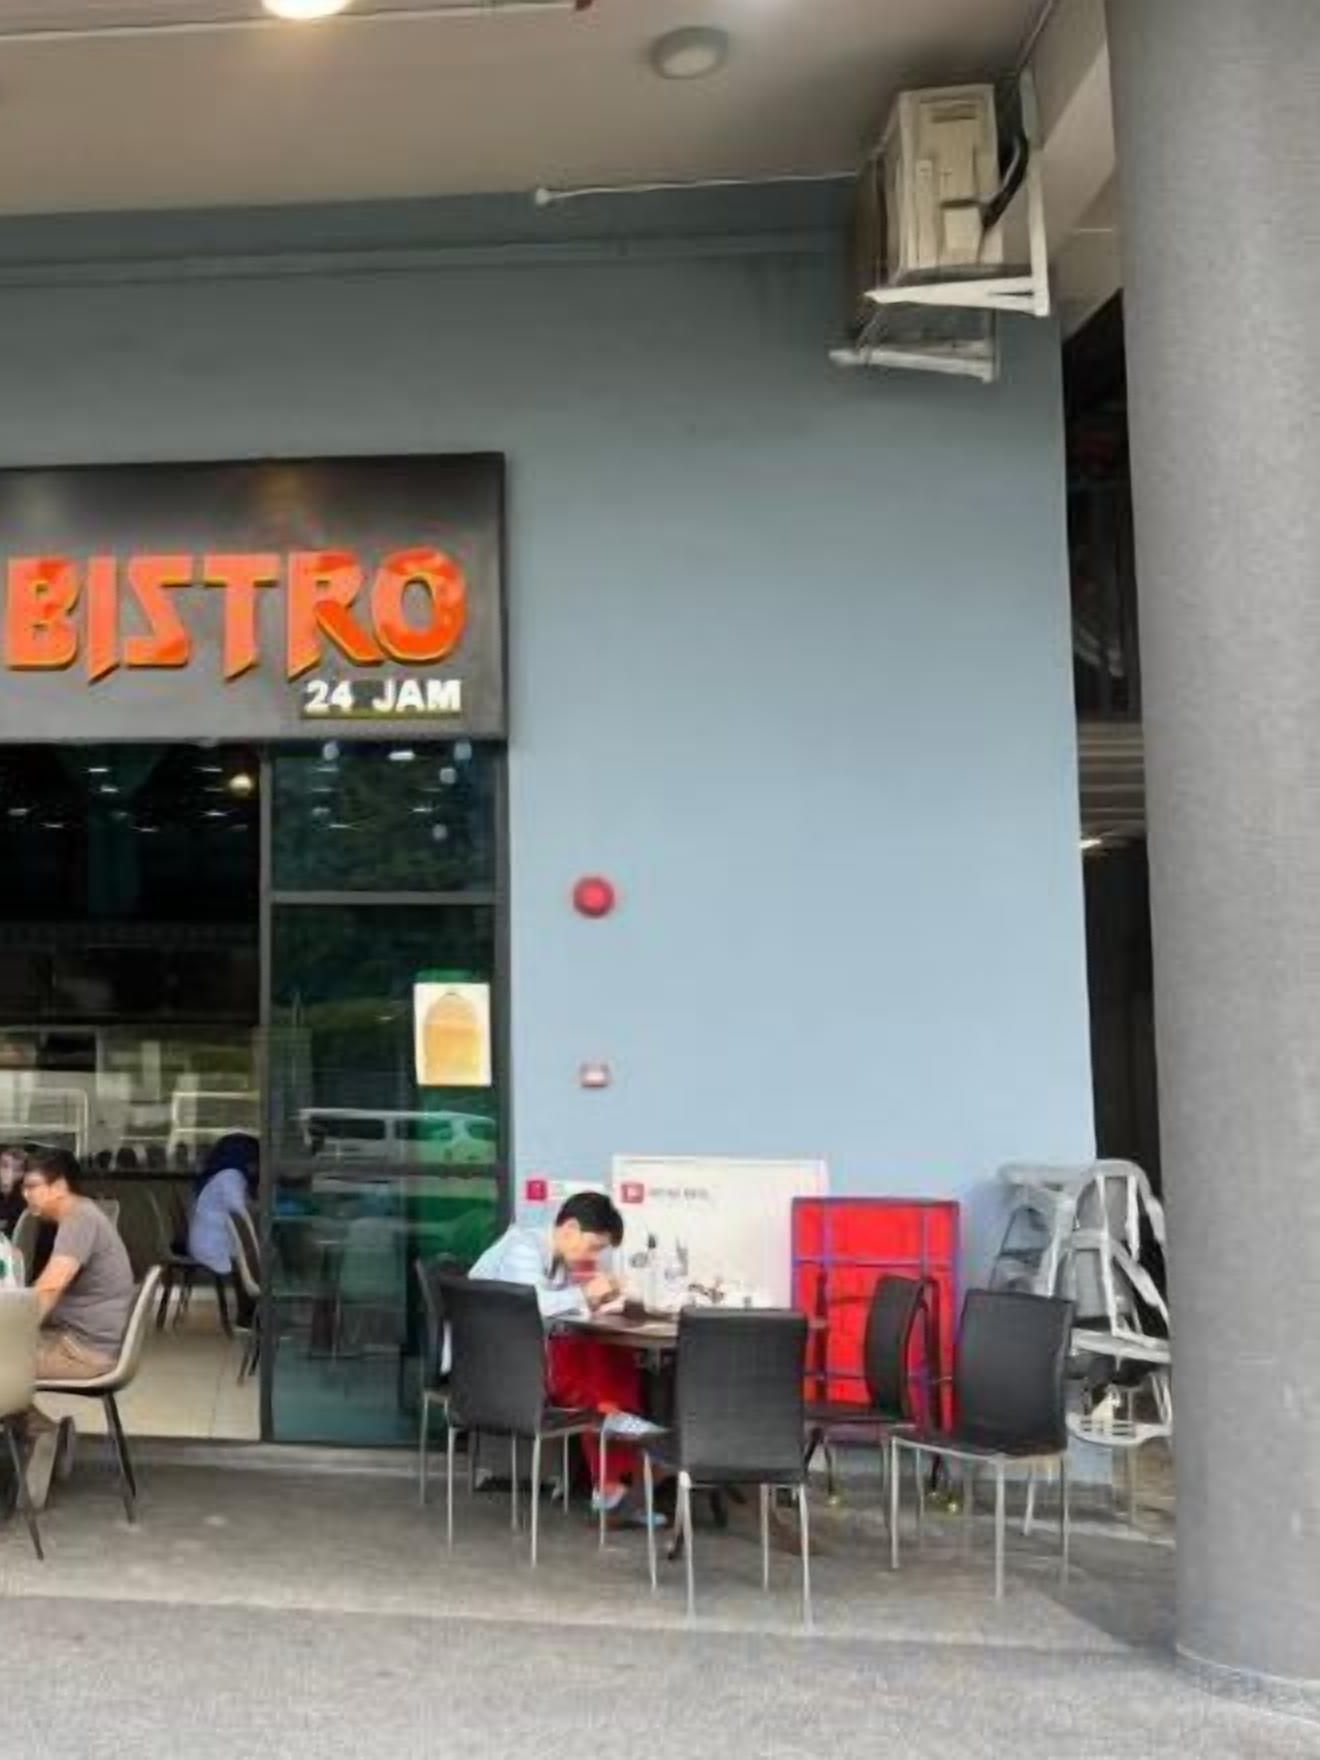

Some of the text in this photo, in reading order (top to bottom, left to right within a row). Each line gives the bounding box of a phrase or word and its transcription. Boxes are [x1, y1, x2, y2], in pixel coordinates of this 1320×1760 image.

[5, 548, 467, 681] BISTRO
[302, 679, 463, 714] 24 JAM
